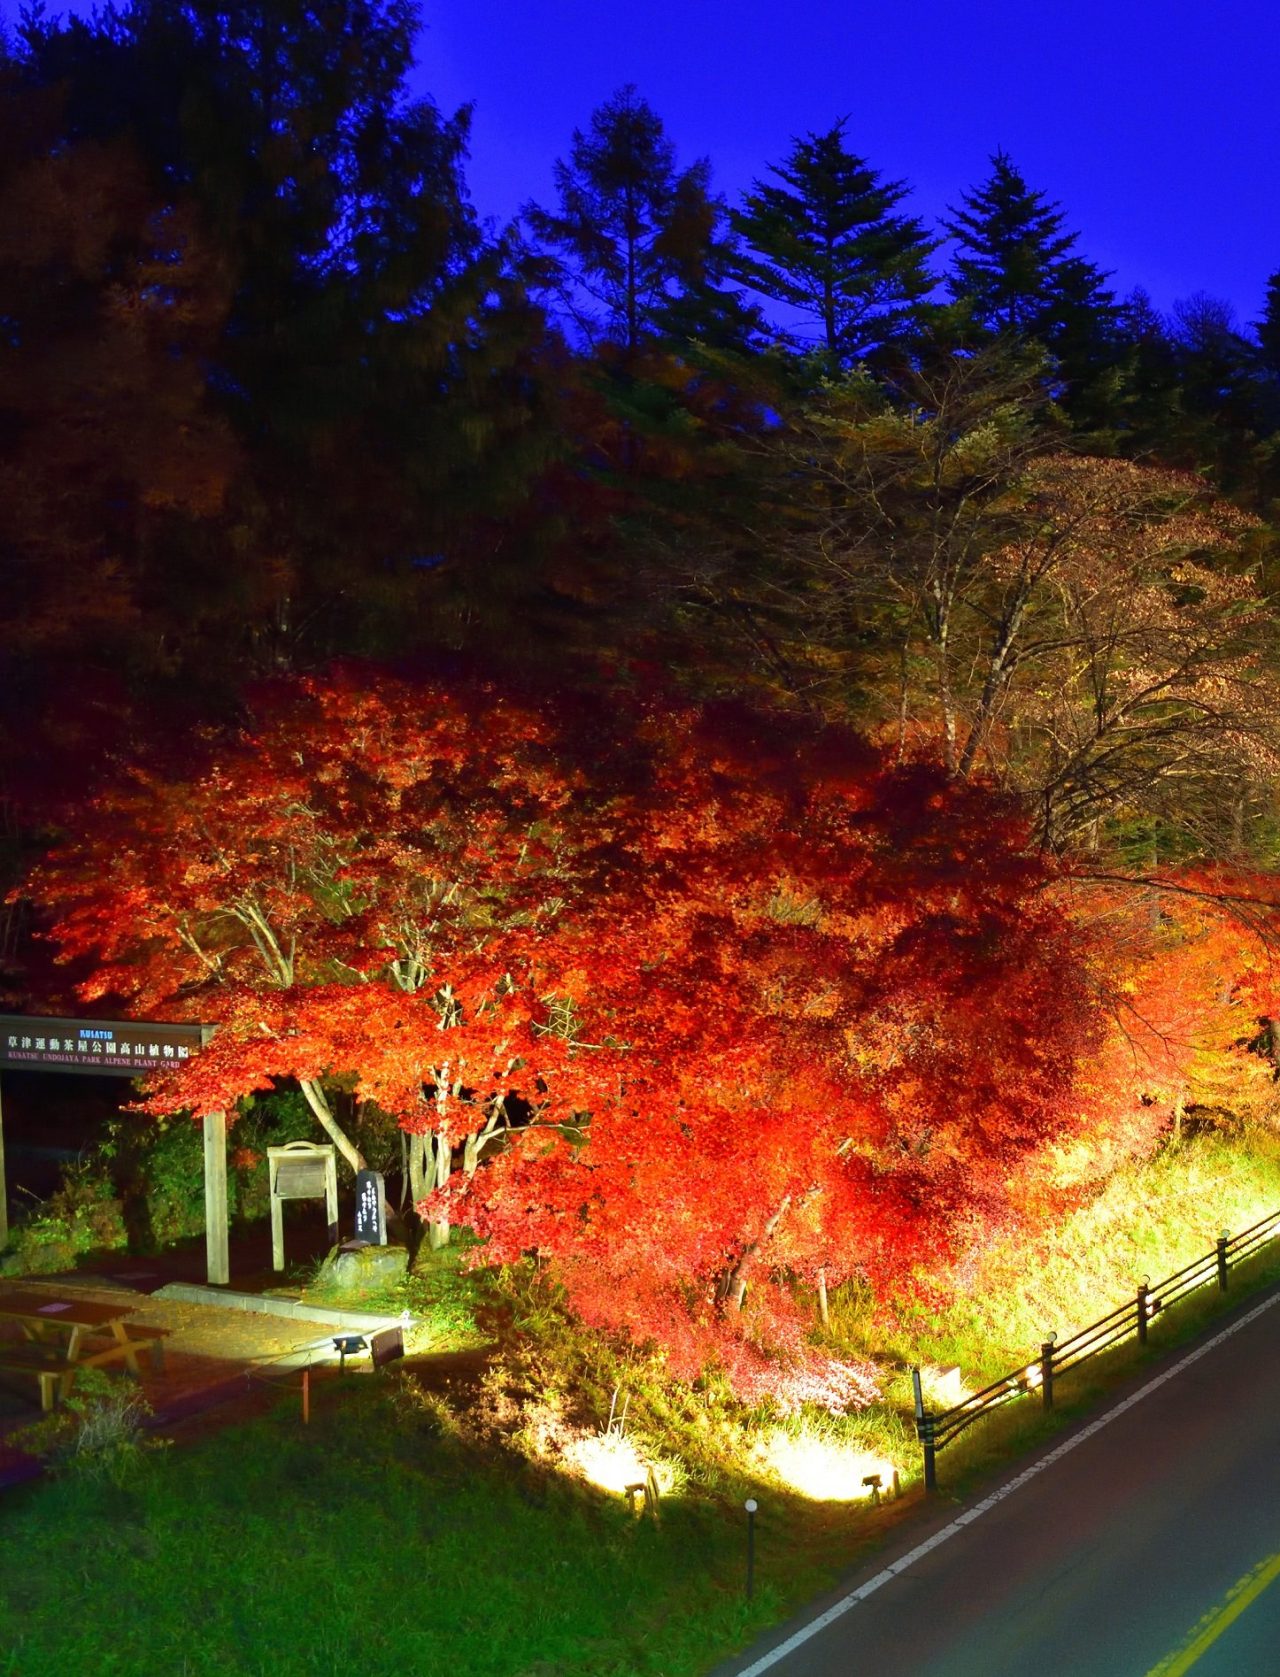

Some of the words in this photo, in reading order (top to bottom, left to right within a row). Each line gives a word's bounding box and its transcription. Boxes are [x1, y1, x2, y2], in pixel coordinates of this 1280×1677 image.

[8, 1051, 39, 1060] KUSATSU
[82, 1056, 100, 1064] PARK
[134, 1058, 157, 1068] PLANT
